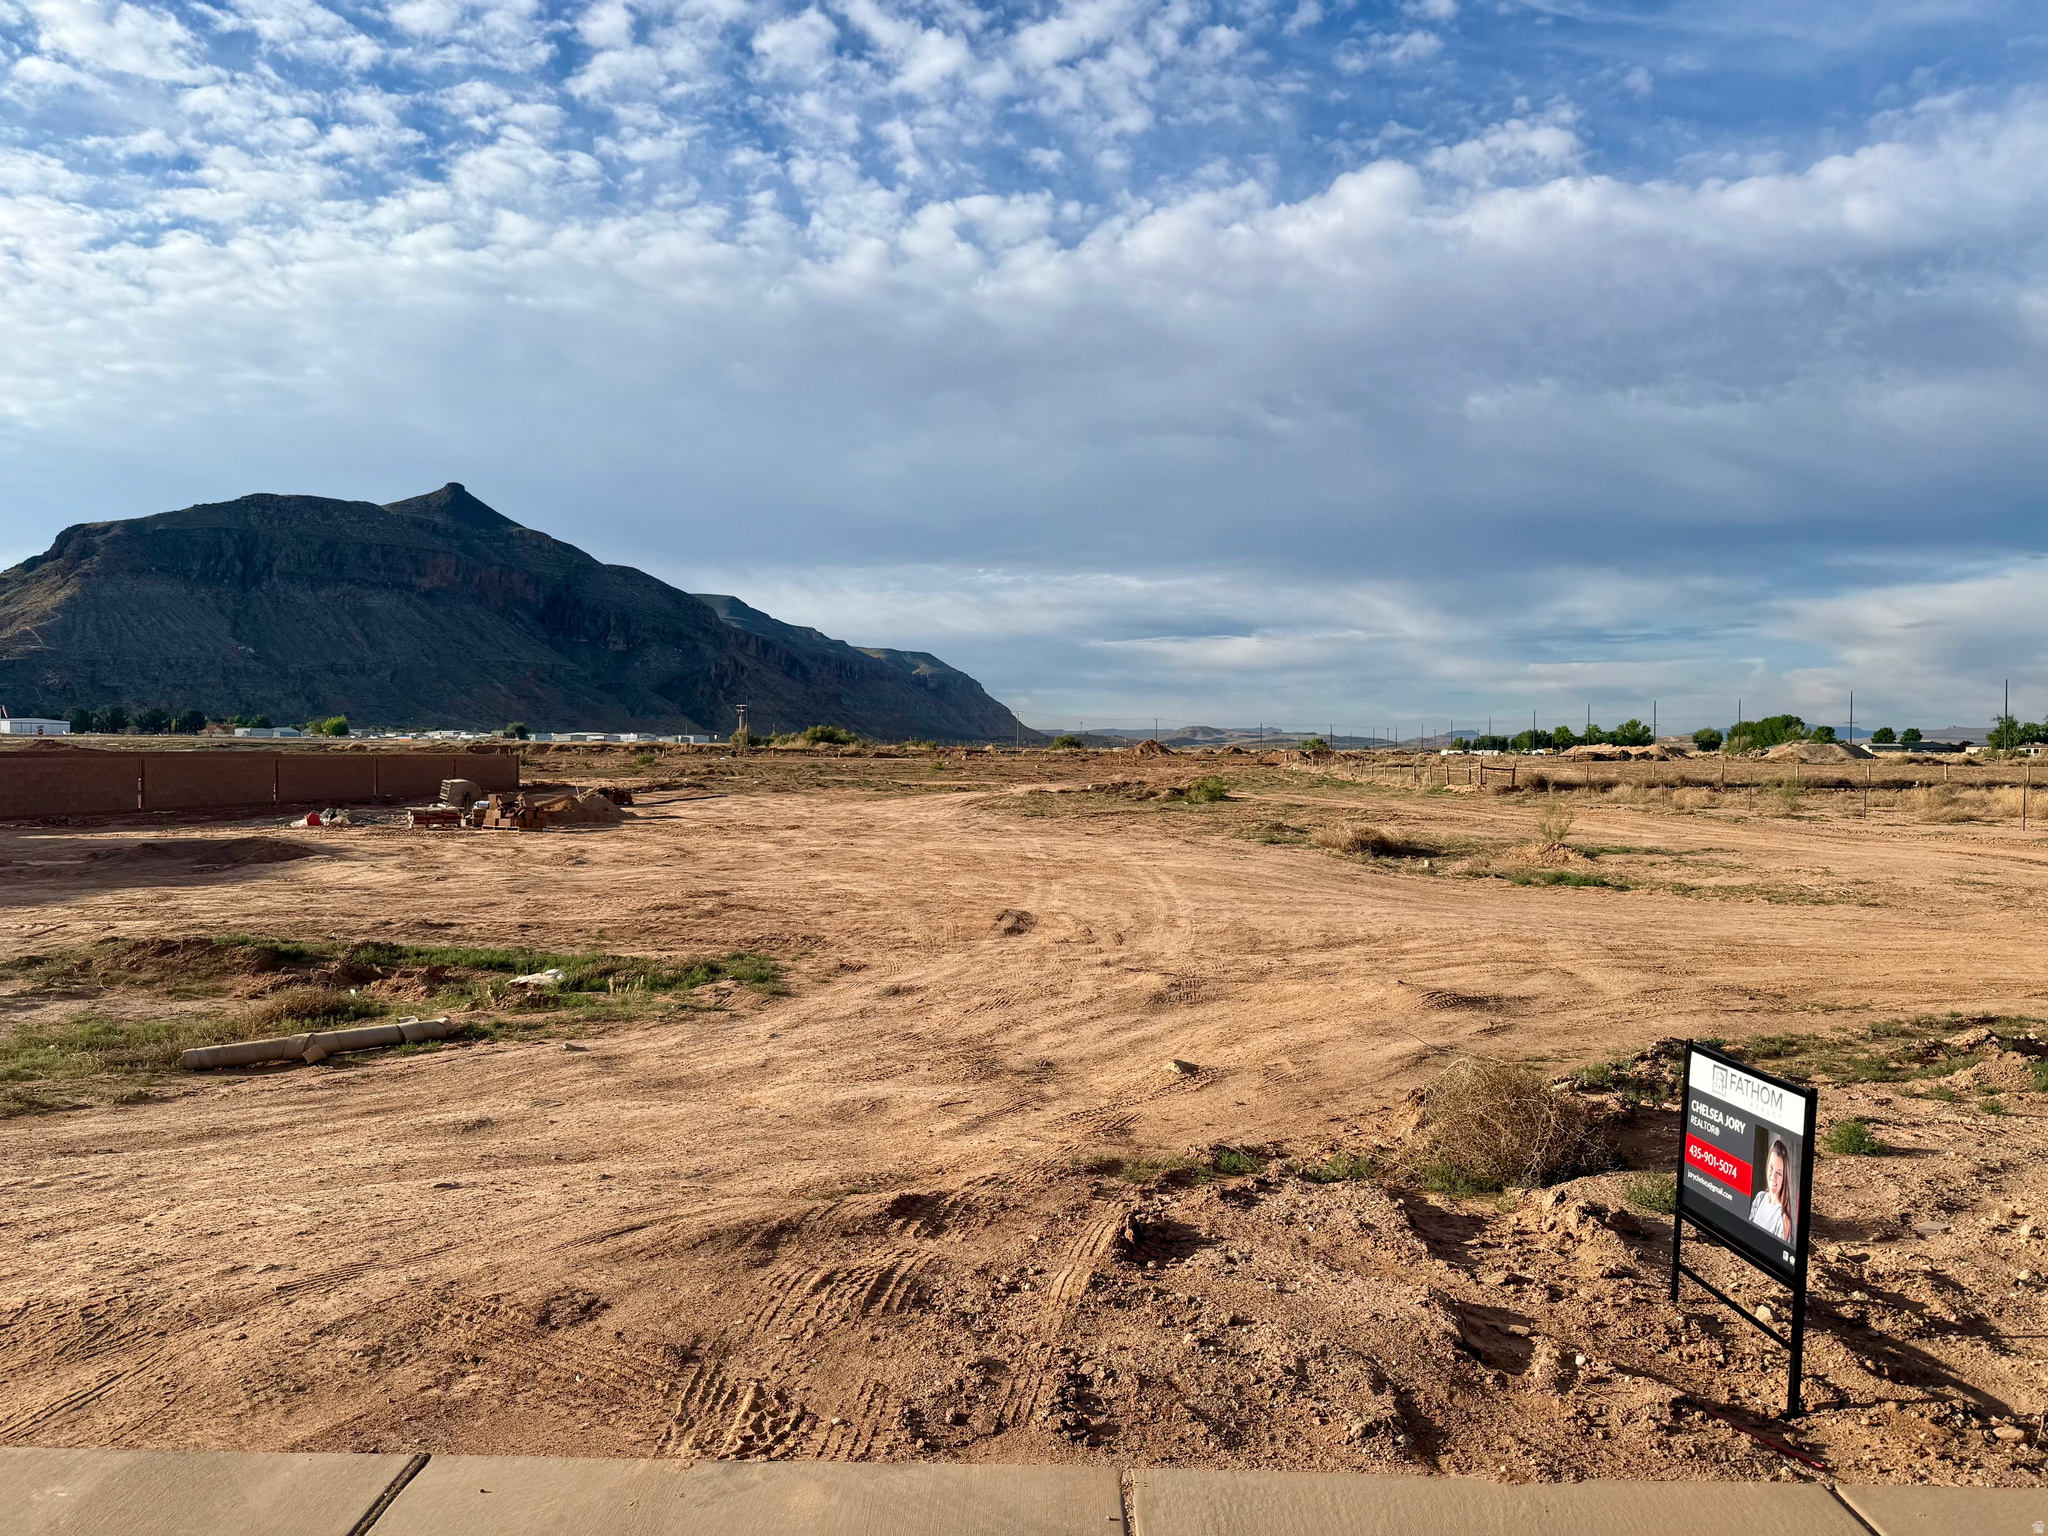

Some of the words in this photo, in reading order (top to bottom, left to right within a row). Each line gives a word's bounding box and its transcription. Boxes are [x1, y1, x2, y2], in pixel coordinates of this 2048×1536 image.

[1730, 1074, 1783, 1111] FATHOM
[1691, 1099, 1724, 1125] CHELSEA
[1724, 1115, 1746, 1135] JORY
[1750, 1102, 1782, 1119] REALTY
[1689, 1144, 1737, 1179] 435-901-5074
